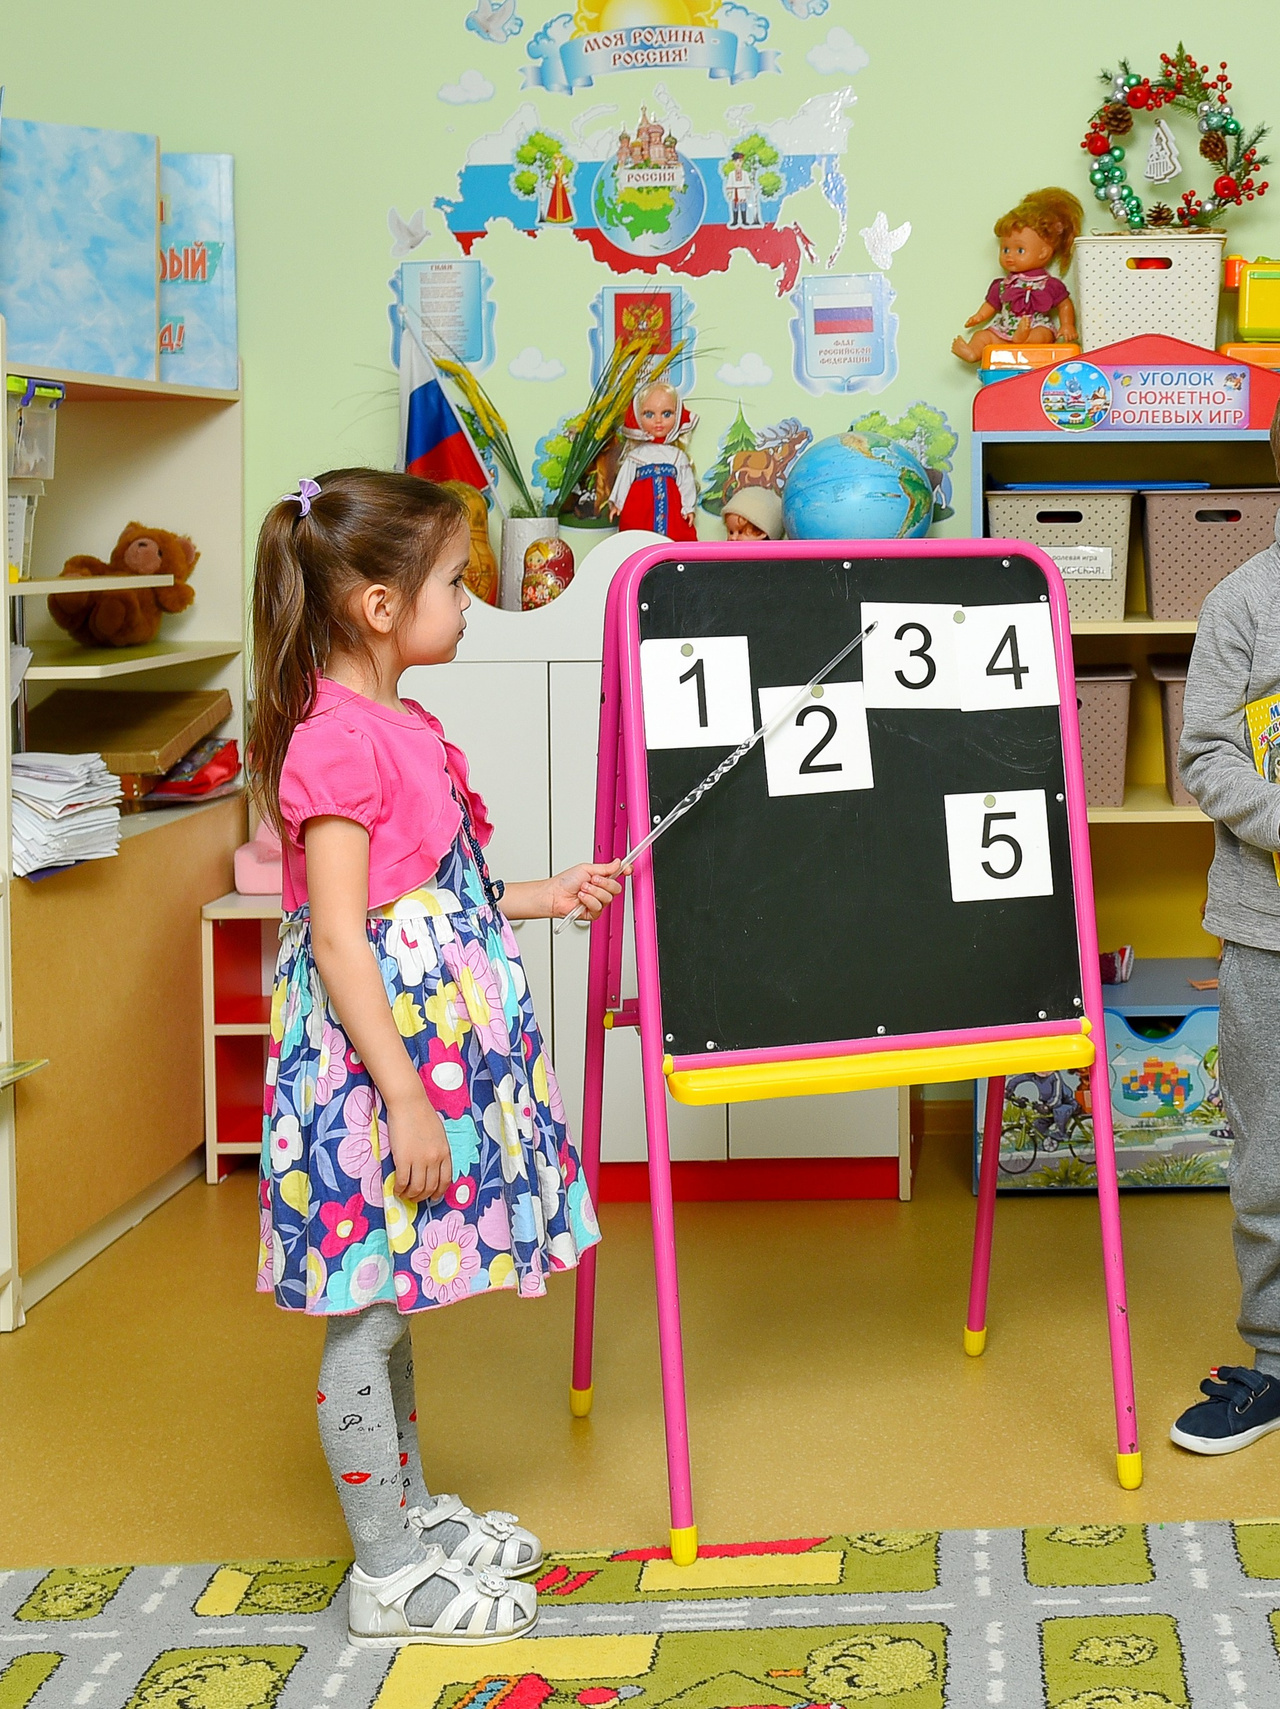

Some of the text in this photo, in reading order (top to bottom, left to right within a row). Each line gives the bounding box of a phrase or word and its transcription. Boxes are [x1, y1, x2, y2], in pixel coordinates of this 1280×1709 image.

[584, 32, 626, 53] МОЯ
[632, 29, 706, 45] РОДИНА
[612, 47, 689, 66] РОССИЯ!
[627, 172, 675, 183] РОССИЯ
[818, 347, 871, 356] РОССИЙСКОЙ
[819, 356, 871, 365] ФЕДЕРАЦИИ
[1139, 372, 1214, 387] УГОЛОК
[1126, 390, 1233, 406] СЮЖЕТНО-
[1111, 409, 1244, 425] РОЛЕВЫХ ИГР
[894, 622, 1030, 690] 3 4
[678, 658, 709, 728] 1
[794, 705, 843, 775] 2
[980, 811, 1023, 880] 5
